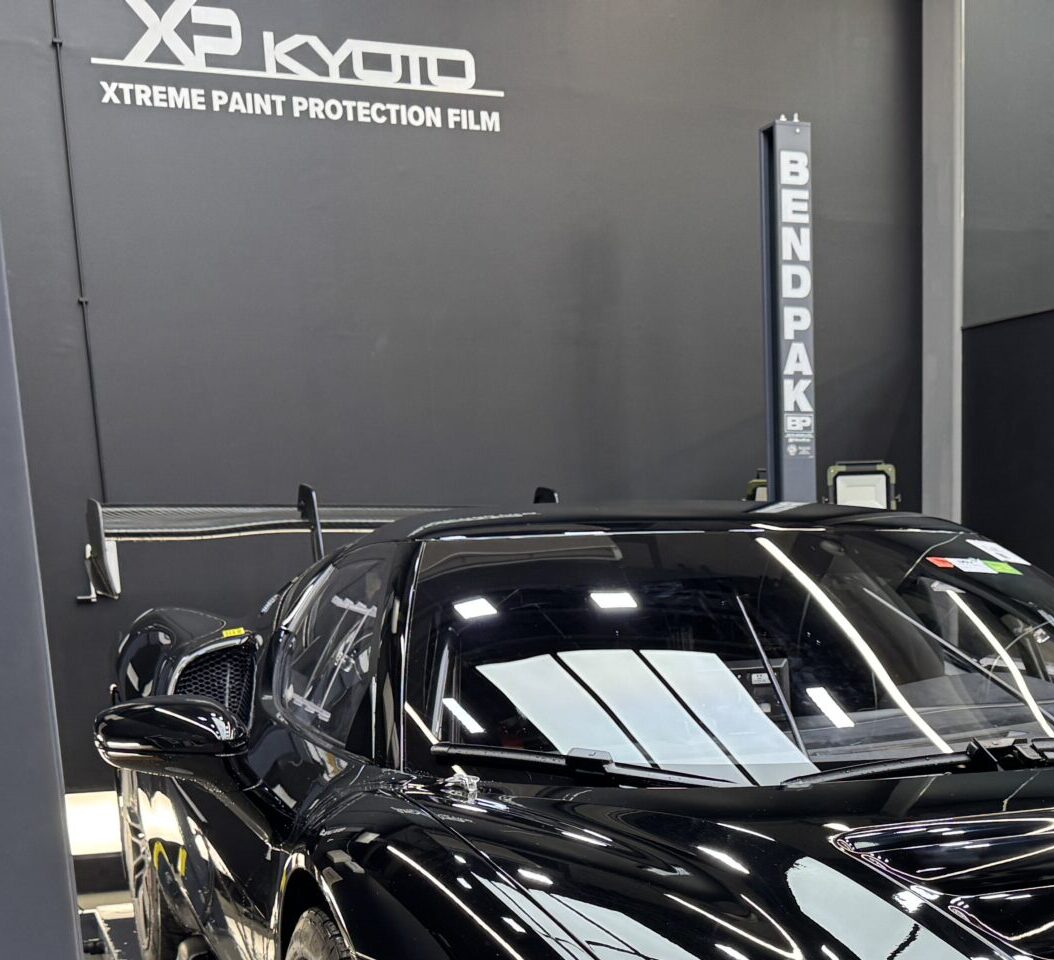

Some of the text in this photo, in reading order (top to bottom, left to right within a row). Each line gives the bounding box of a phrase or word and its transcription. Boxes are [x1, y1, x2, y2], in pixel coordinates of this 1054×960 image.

[123, 0, 476, 91] XP KYOTO
[100, 80, 501, 132] XTREME PAINT PROTECTION FILM
[780, 151, 814, 412] BENDPAK
